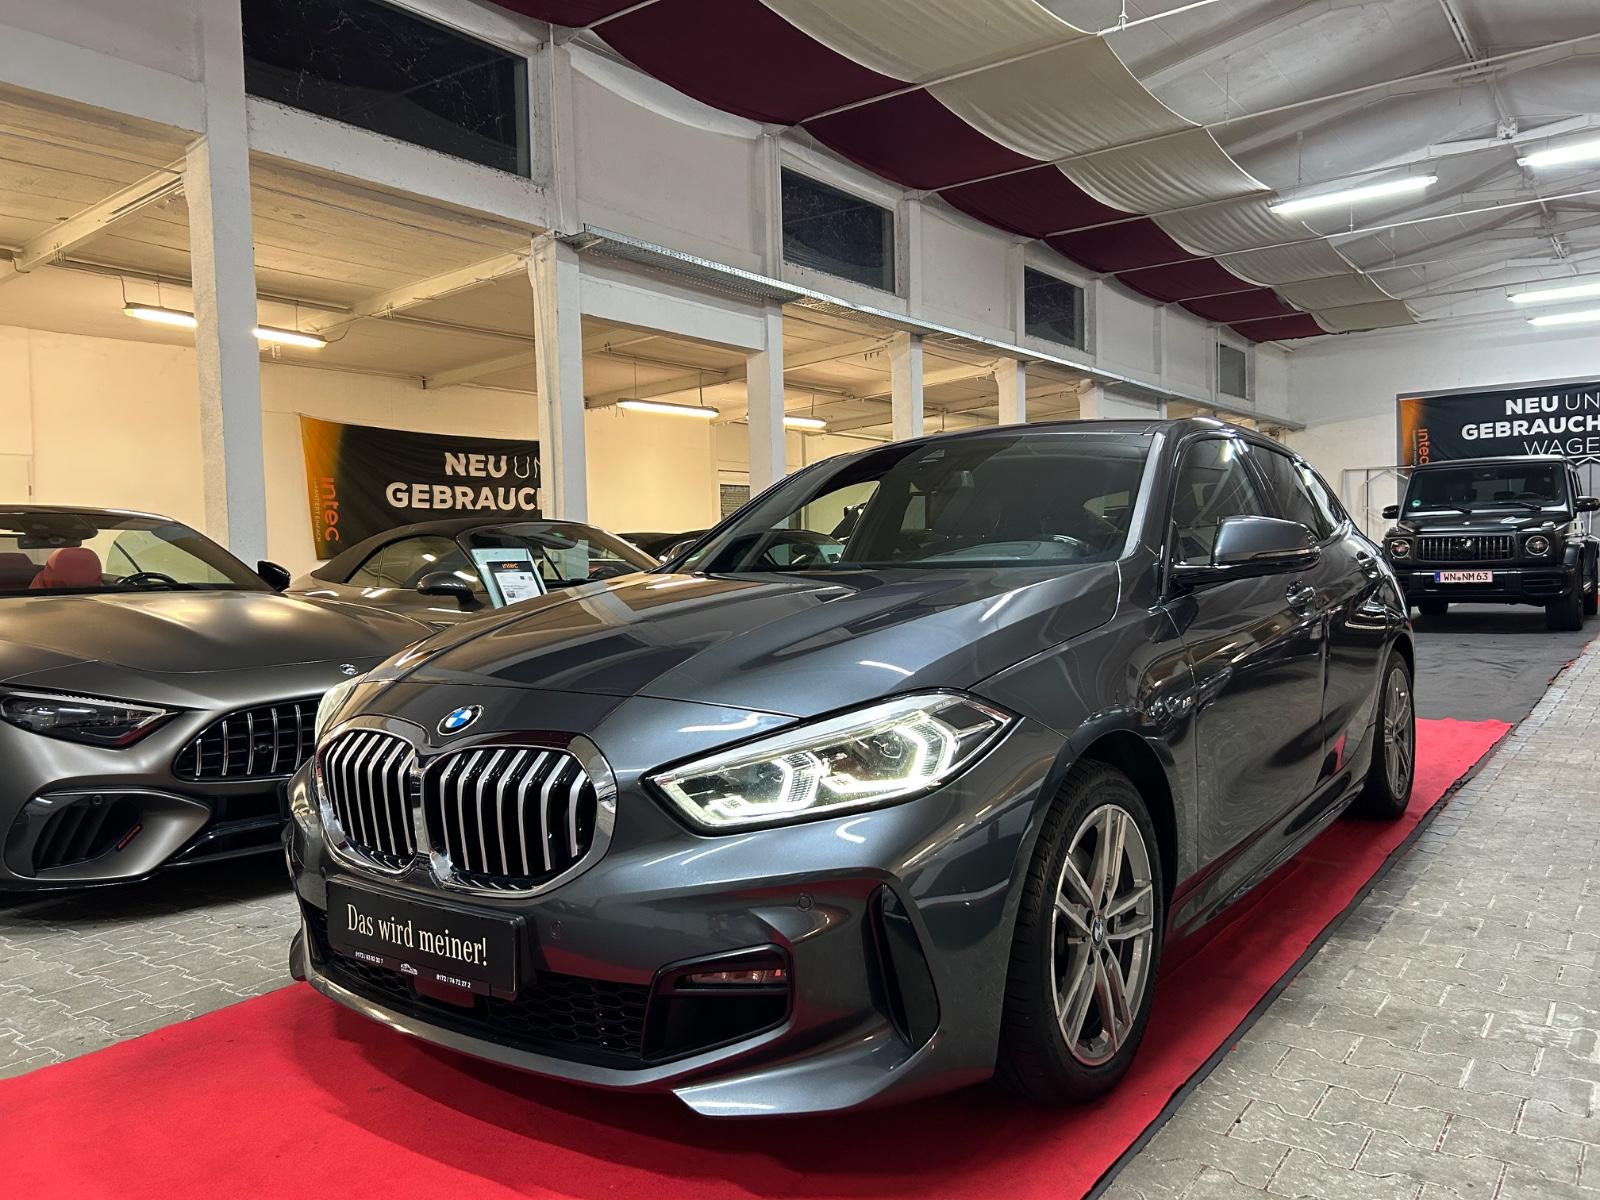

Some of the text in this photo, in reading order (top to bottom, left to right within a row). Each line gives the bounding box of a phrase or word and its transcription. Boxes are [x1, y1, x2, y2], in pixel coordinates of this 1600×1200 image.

[1505, 392, 1600, 415] NEU UN
[1461, 414, 1600, 440] GEBRAUCH
[1523, 437, 1600, 455] WAGE
[444, 452, 508, 478] NEU
[320, 476, 340, 542] intec
[1443, 572, 1488, 581] WN NM 63
[347, 903, 488, 967] Das wird meiner!
